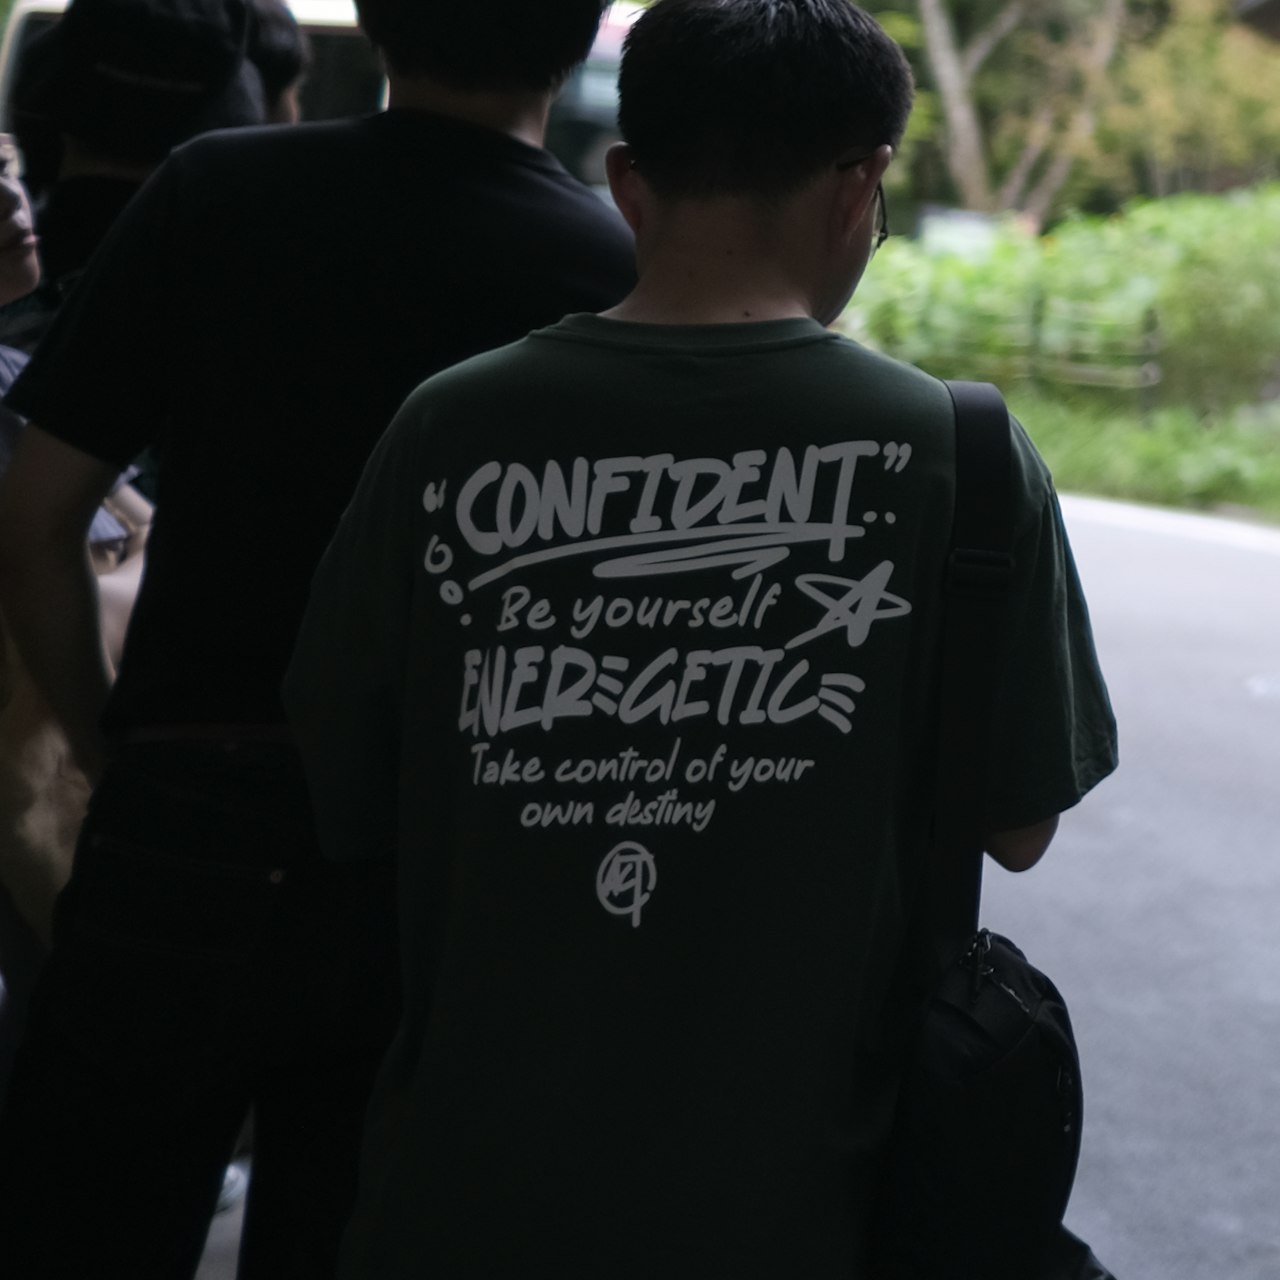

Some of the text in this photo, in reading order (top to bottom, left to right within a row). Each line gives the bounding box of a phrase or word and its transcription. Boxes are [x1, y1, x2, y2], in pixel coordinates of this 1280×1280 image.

[497, 573, 782, 639] Be yourself
[471, 736, 816, 793] Take control of your
[520, 788, 716, 833] own destiny
